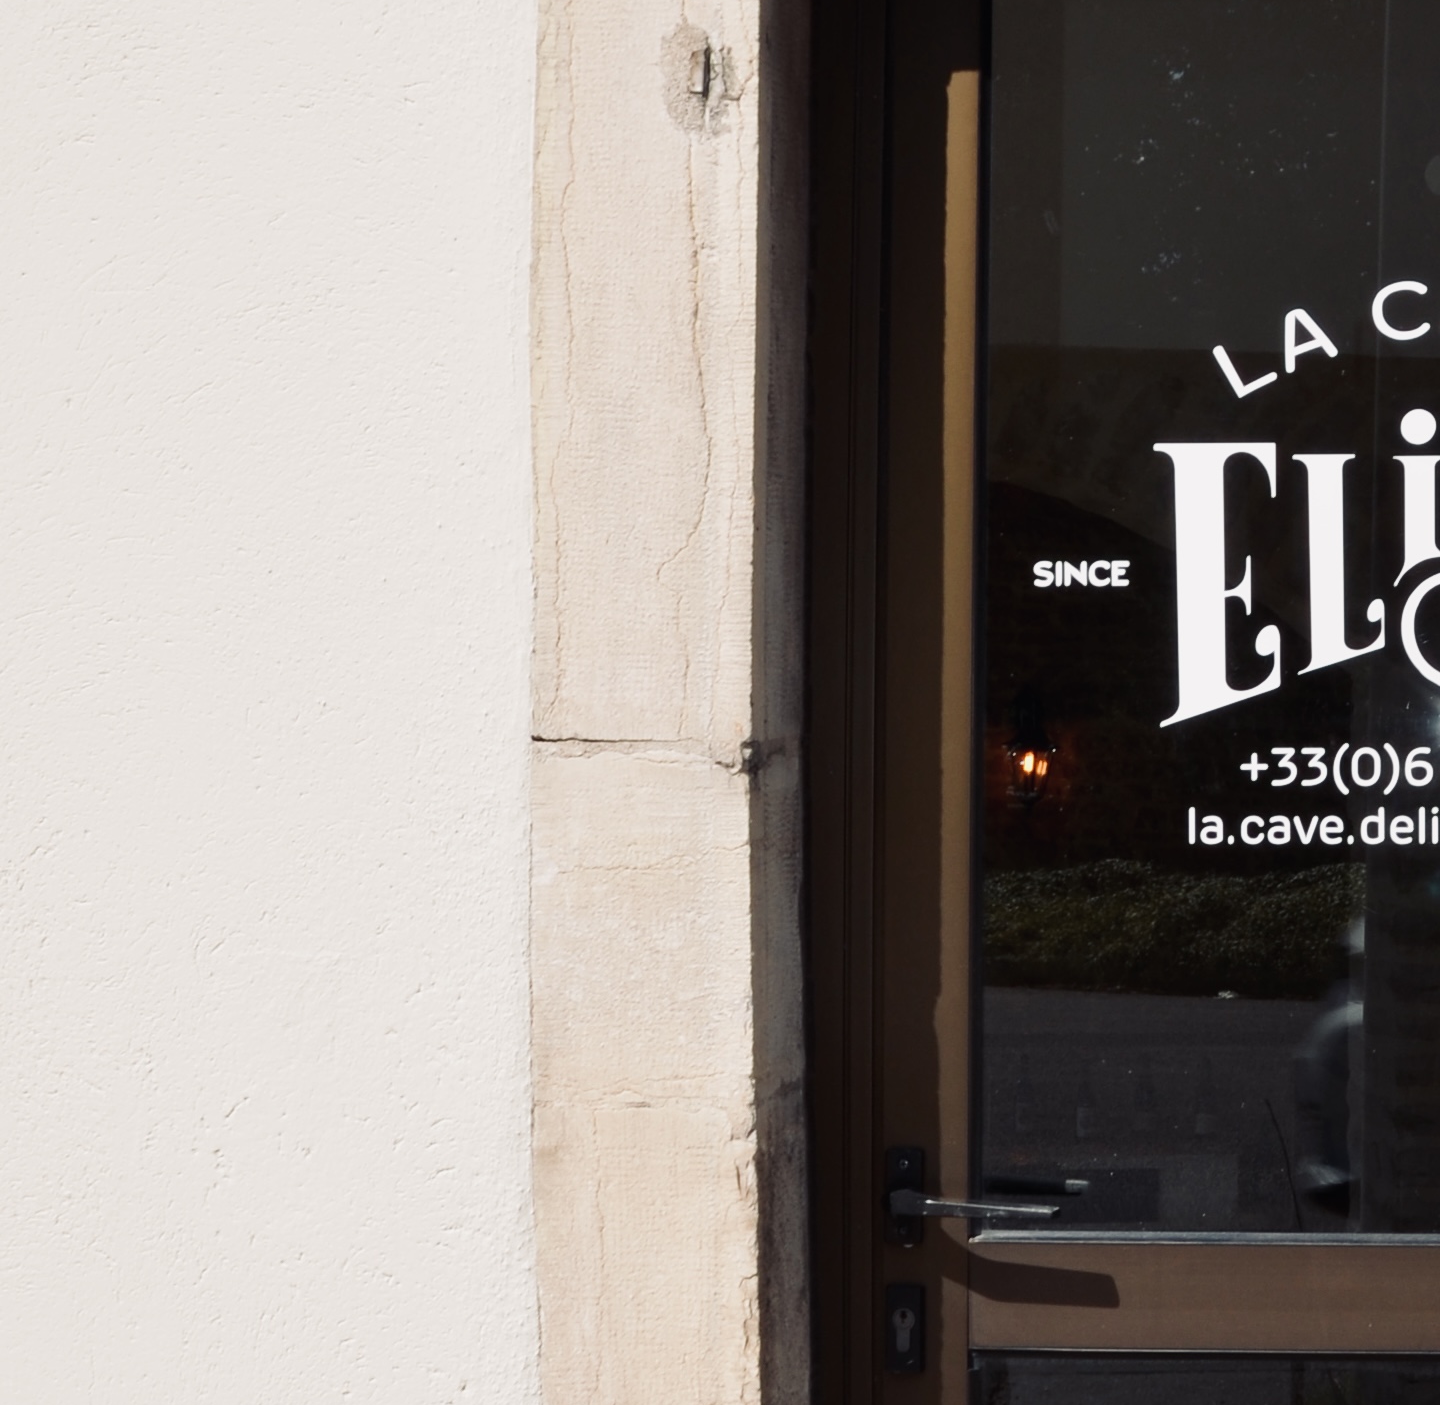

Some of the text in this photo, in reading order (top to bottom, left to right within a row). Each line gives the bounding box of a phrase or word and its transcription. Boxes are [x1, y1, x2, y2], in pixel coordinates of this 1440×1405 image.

[1212, 308, 1339, 399] LA
[1032, 559, 1131, 588] SINCE
[1239, 742, 1434, 796] +33(0)6
